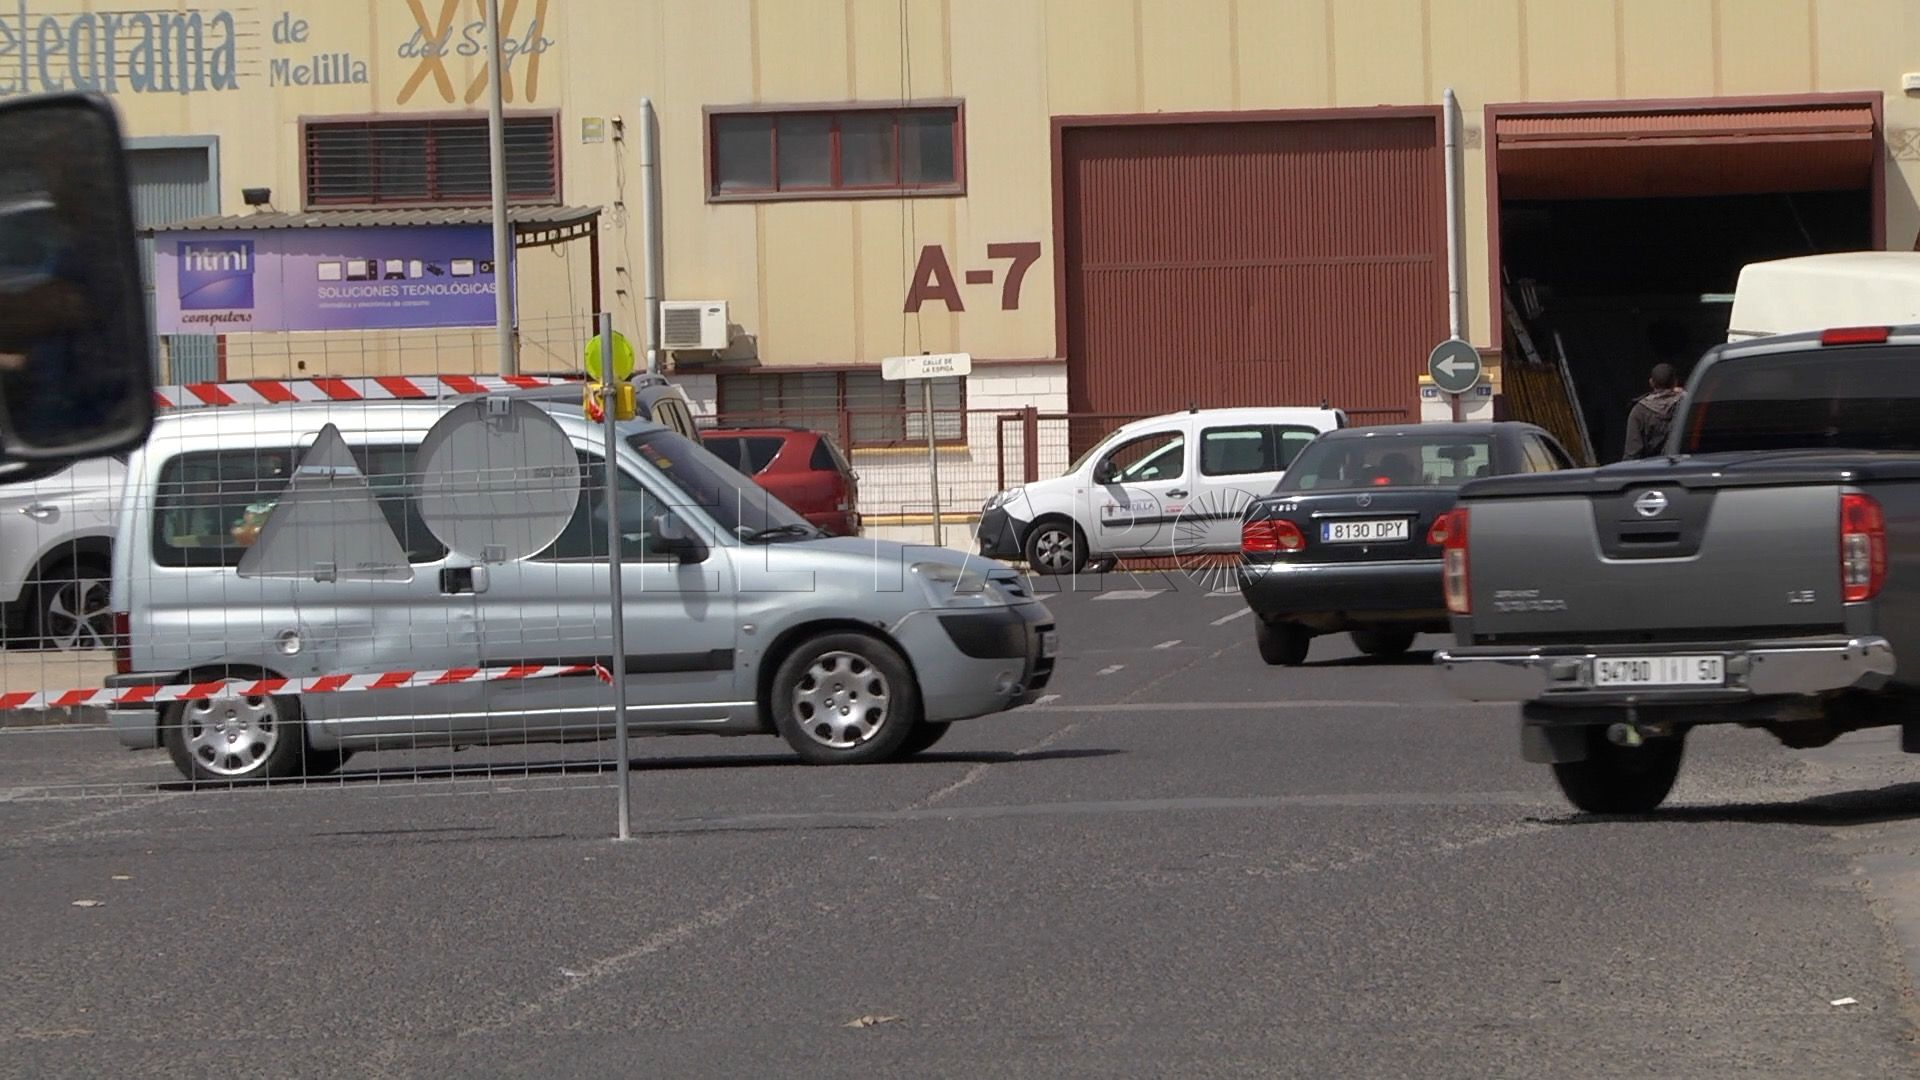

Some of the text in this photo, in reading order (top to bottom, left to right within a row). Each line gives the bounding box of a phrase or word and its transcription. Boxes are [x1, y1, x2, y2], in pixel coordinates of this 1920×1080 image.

[272, 11, 309, 44] de
[398, 19, 555, 74] del Sglo
[269, 52, 369, 87] Melilla
[185, 245, 247, 272] html
[318, 280, 497, 299] SOLUCIONES TECNOLÓGICAS
[903, 241, 1041, 313] A-7
[182, 311, 252, 326] computers
[1334, 522, 1403, 538] 8130 DPY
